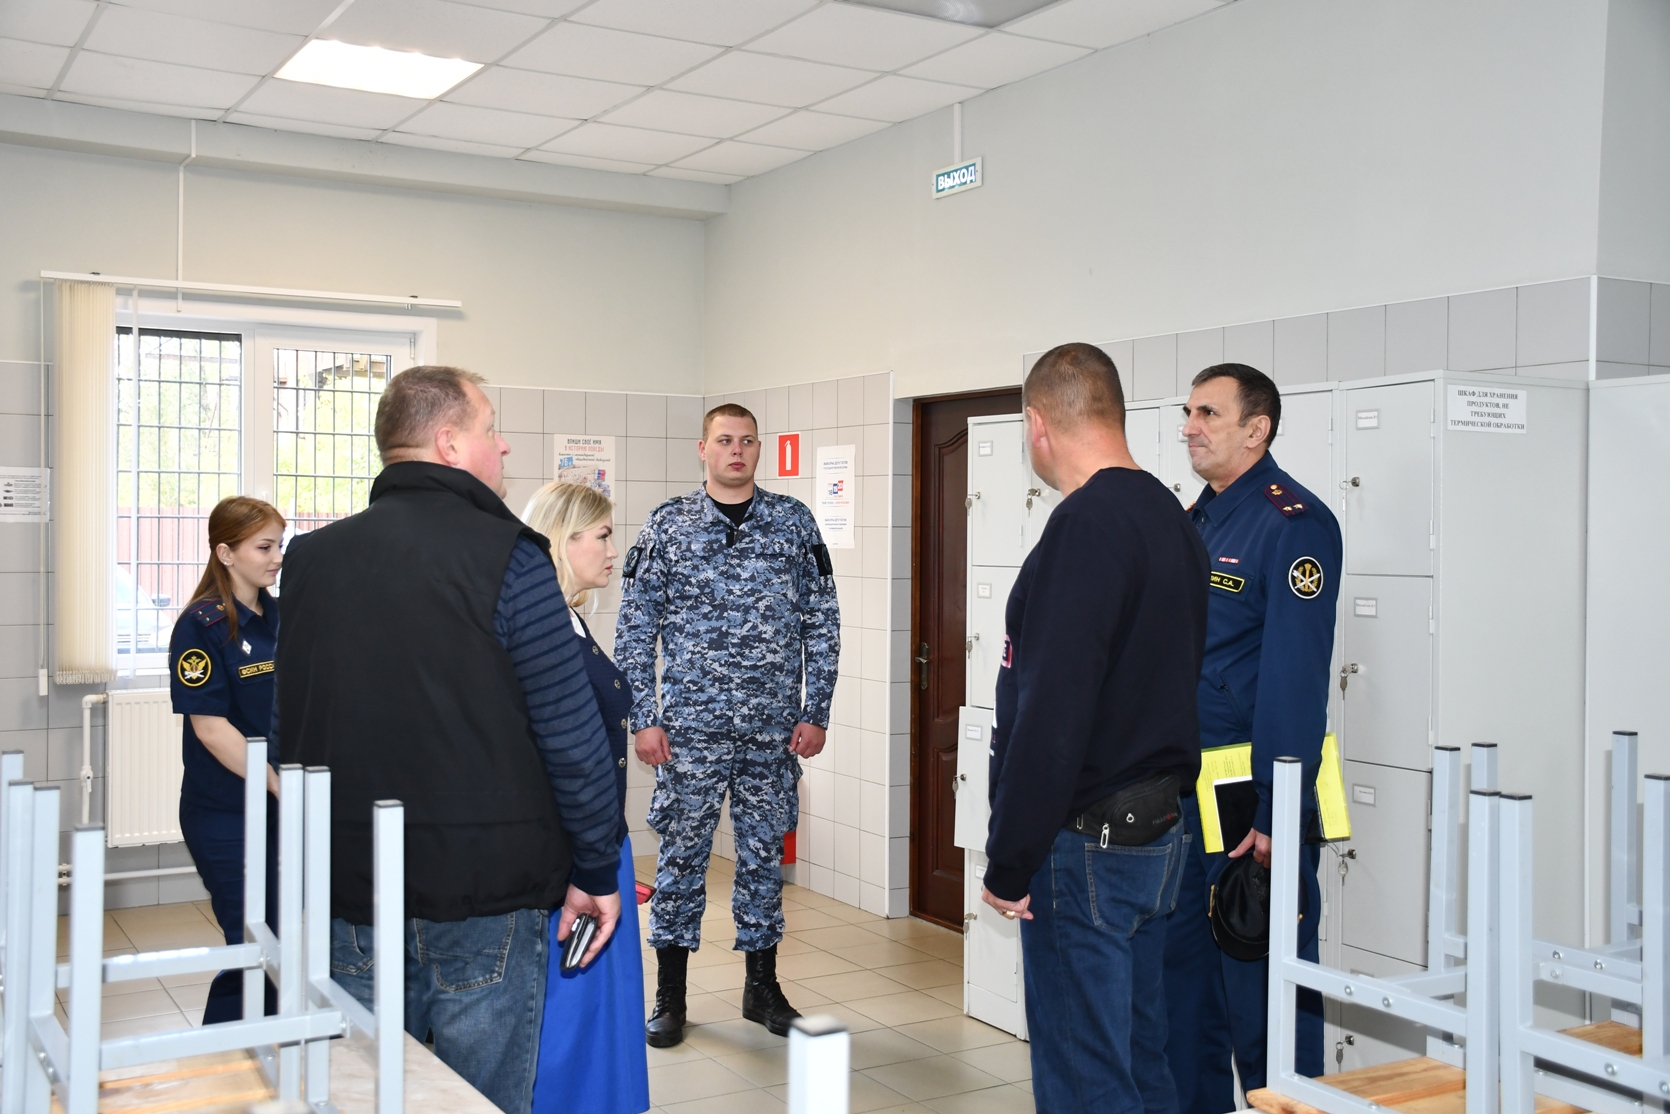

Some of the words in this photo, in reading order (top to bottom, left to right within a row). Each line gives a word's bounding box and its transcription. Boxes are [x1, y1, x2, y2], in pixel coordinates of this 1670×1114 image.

[938, 165, 976, 190] ВЫХОД
[1489, 392, 1518, 400] ХРАНЕНИЯ
[1467, 400, 1501, 409] ПРОДУКТОВ,
[1470, 411, 1506, 419] ТРЕБУЮЩИХ
[1450, 419, 1492, 428] ТЕРМИЧЕСКОЙ
[242, 666, 258, 674] ФСИН
